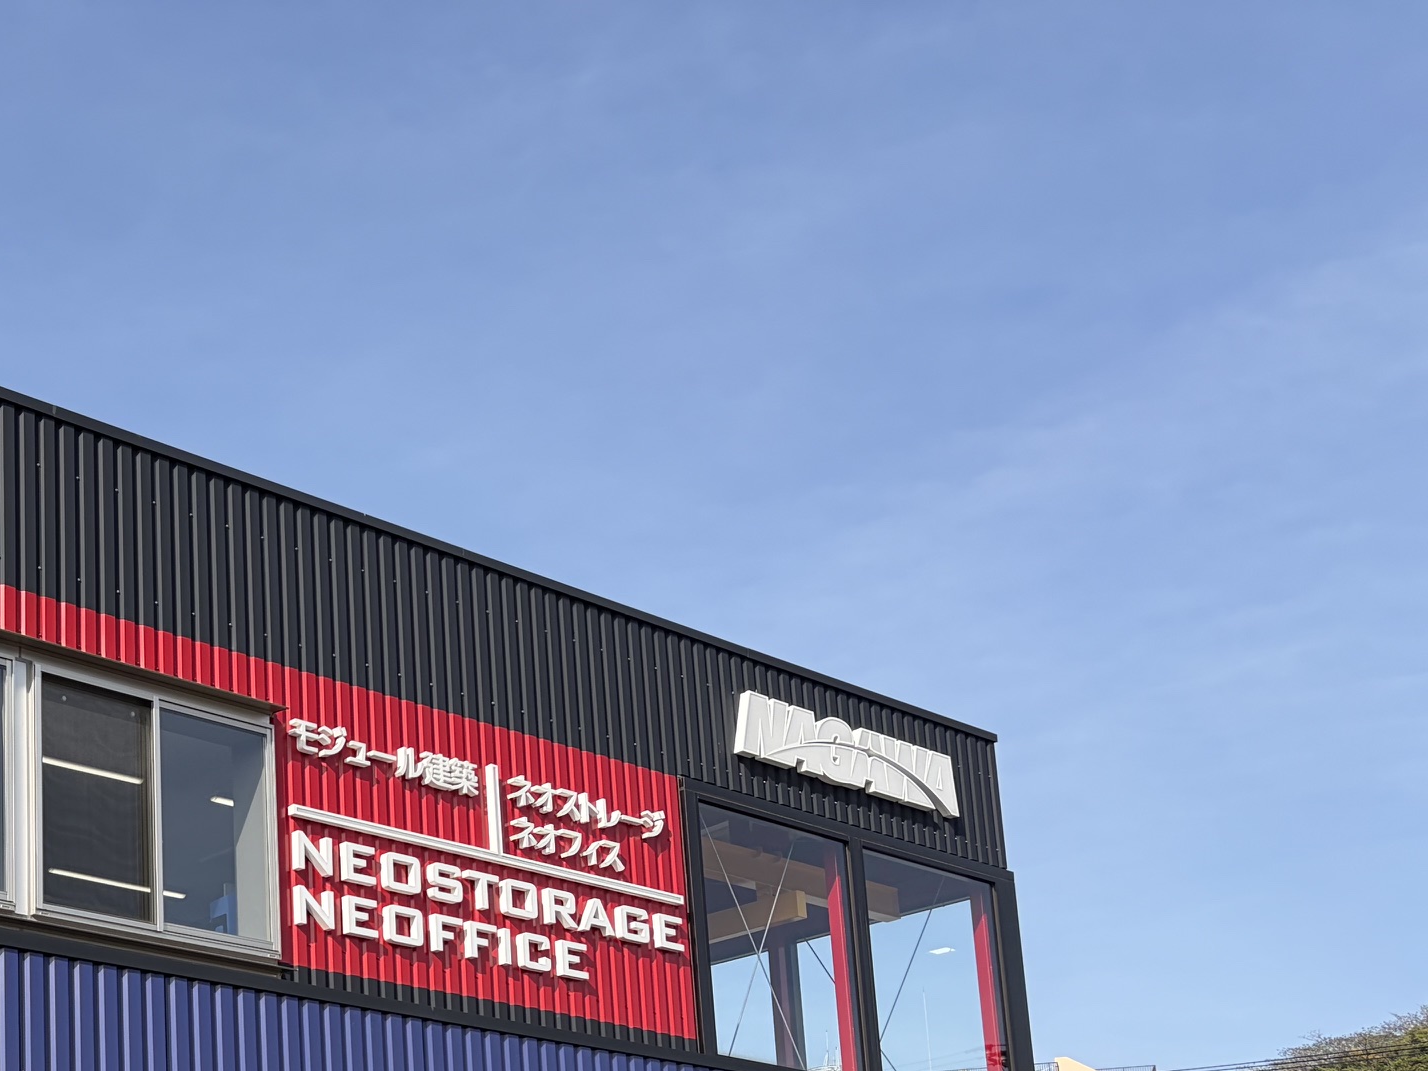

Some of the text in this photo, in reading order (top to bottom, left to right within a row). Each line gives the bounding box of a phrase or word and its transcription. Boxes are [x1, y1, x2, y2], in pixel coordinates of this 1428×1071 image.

[288, 718, 479, 797] モジュール建築
[734, 690, 960, 819] NAGAWA
[507, 775, 665, 839] ネオストレージ
[509, 817, 625, 872] ネオフィス
[291, 830, 685, 952] NEOSTORAGE
[292, 885, 589, 981] NEOFFICE
